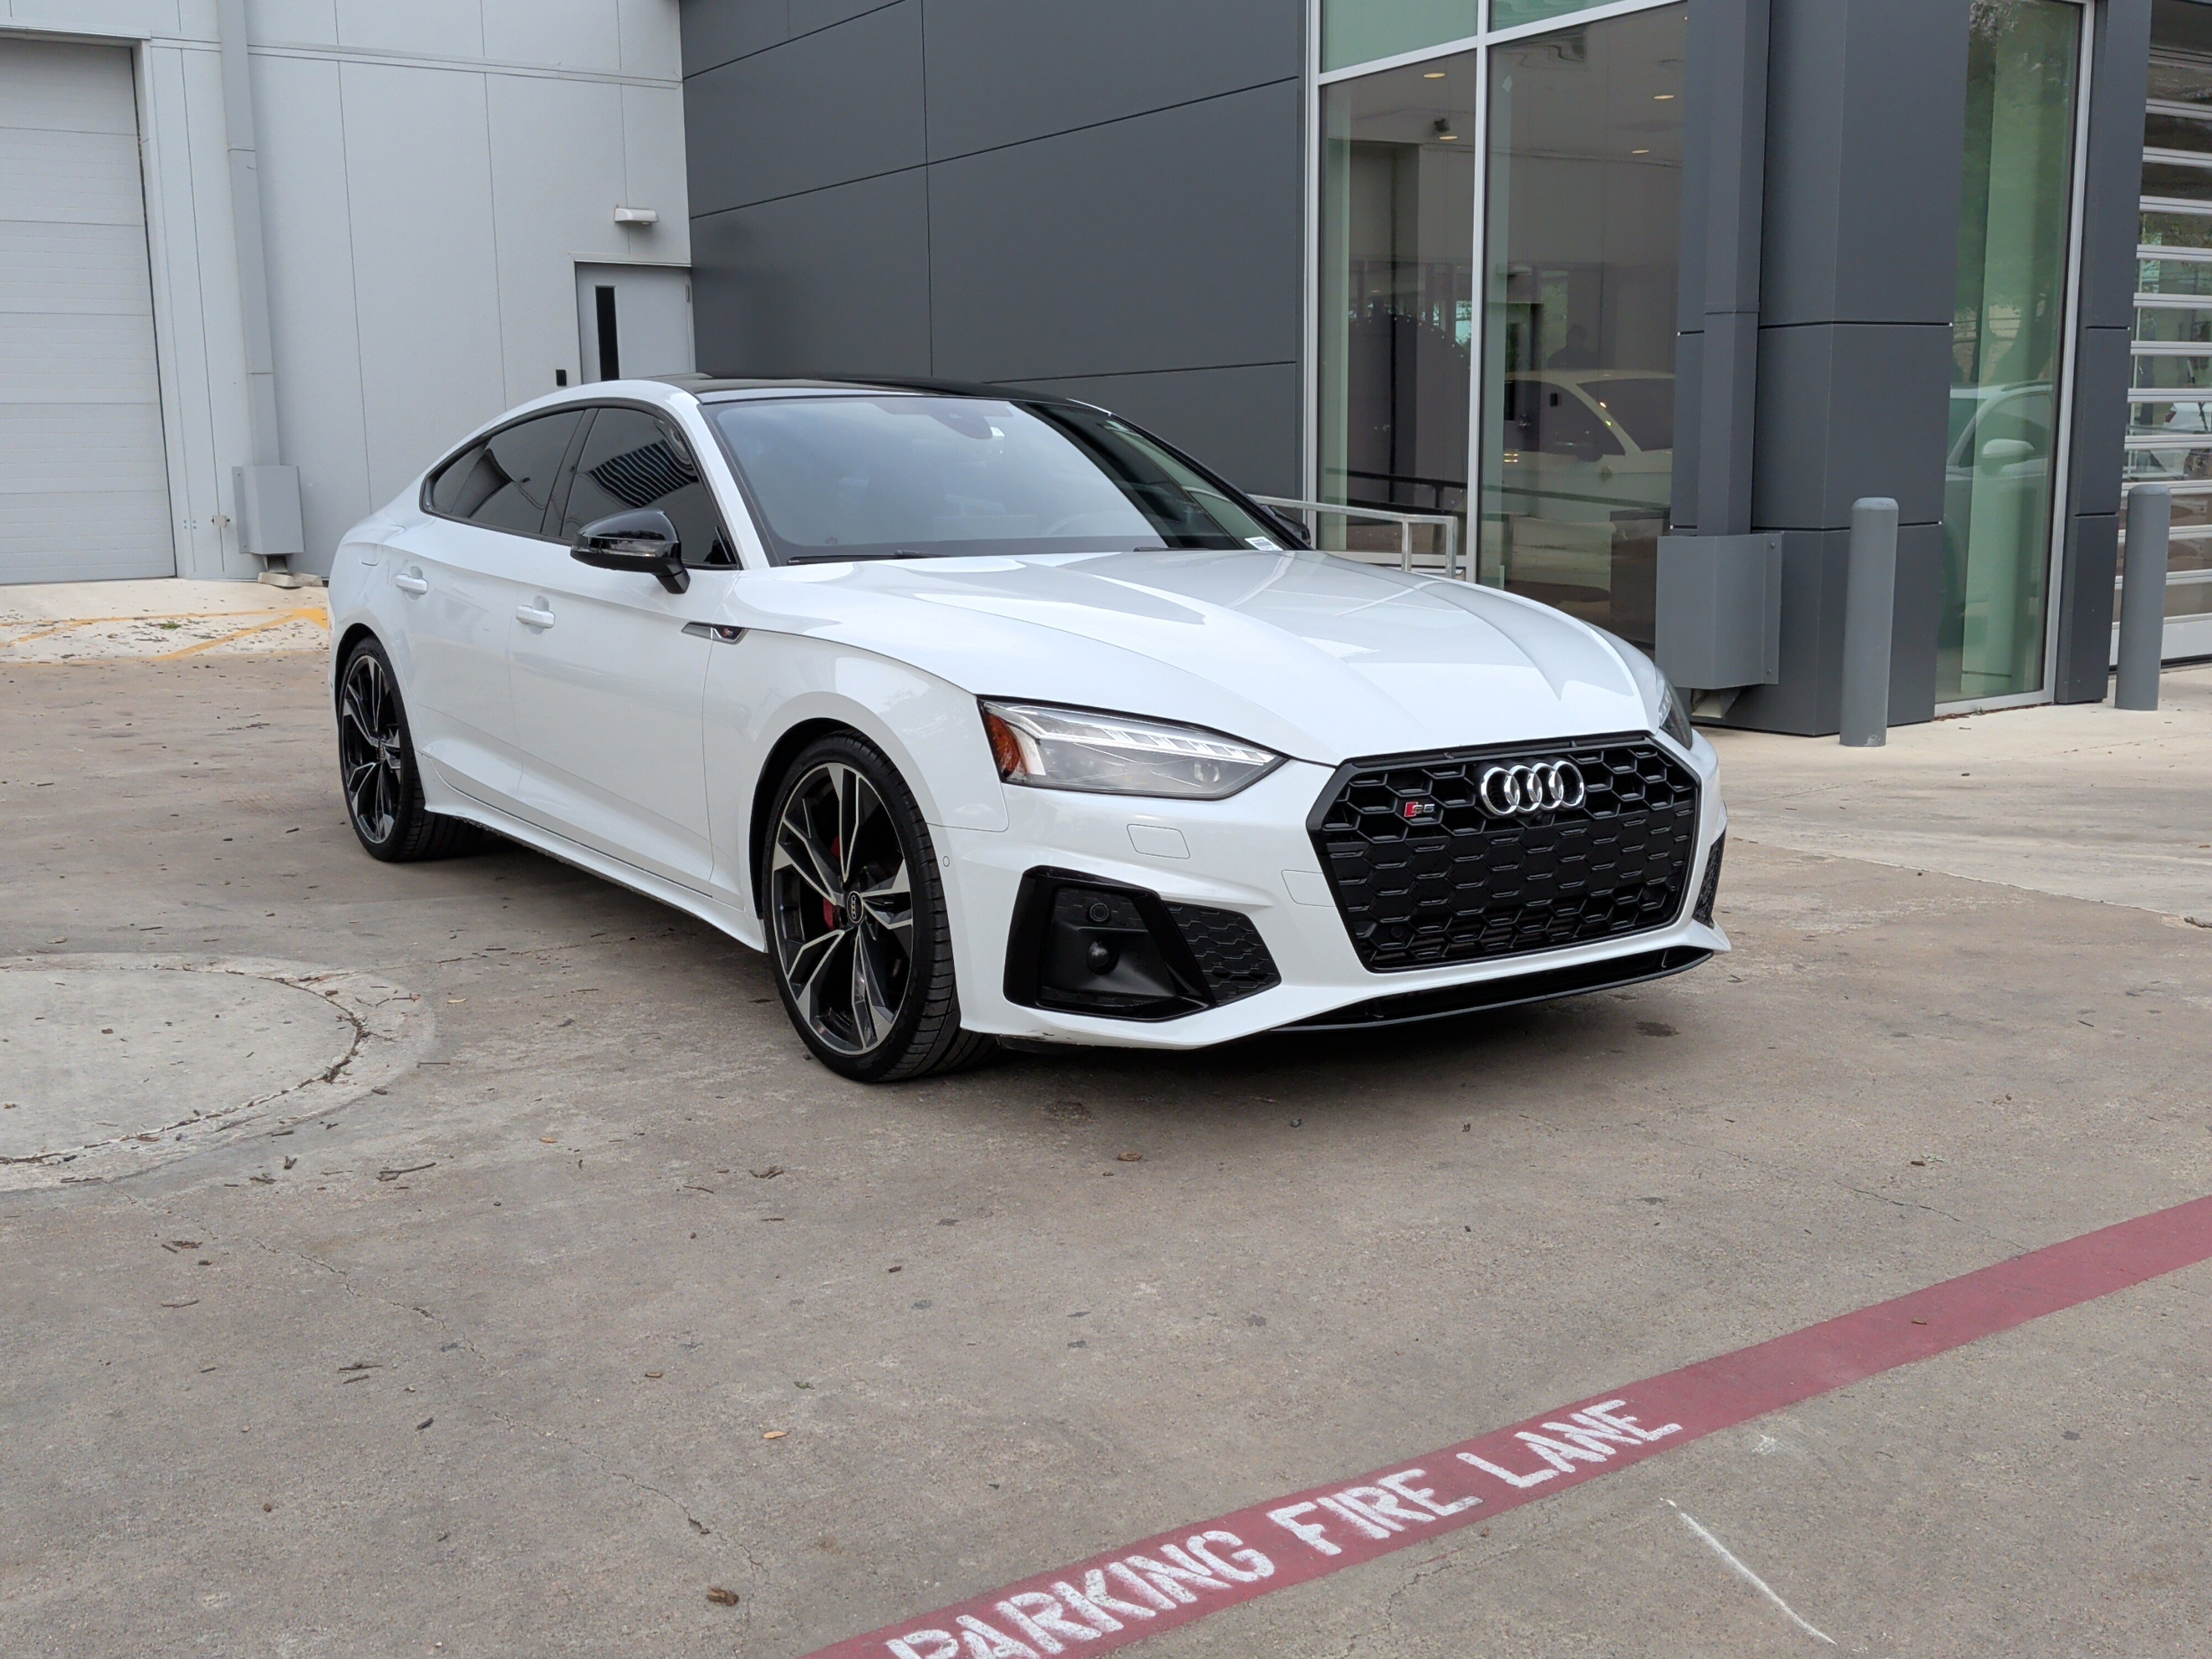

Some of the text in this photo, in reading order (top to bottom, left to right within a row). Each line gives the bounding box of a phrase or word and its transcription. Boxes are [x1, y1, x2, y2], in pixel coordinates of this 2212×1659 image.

[1411, 803, 1436, 815] S5
[886, 1399, 1683, 1659] PARKING FIRE LANE
